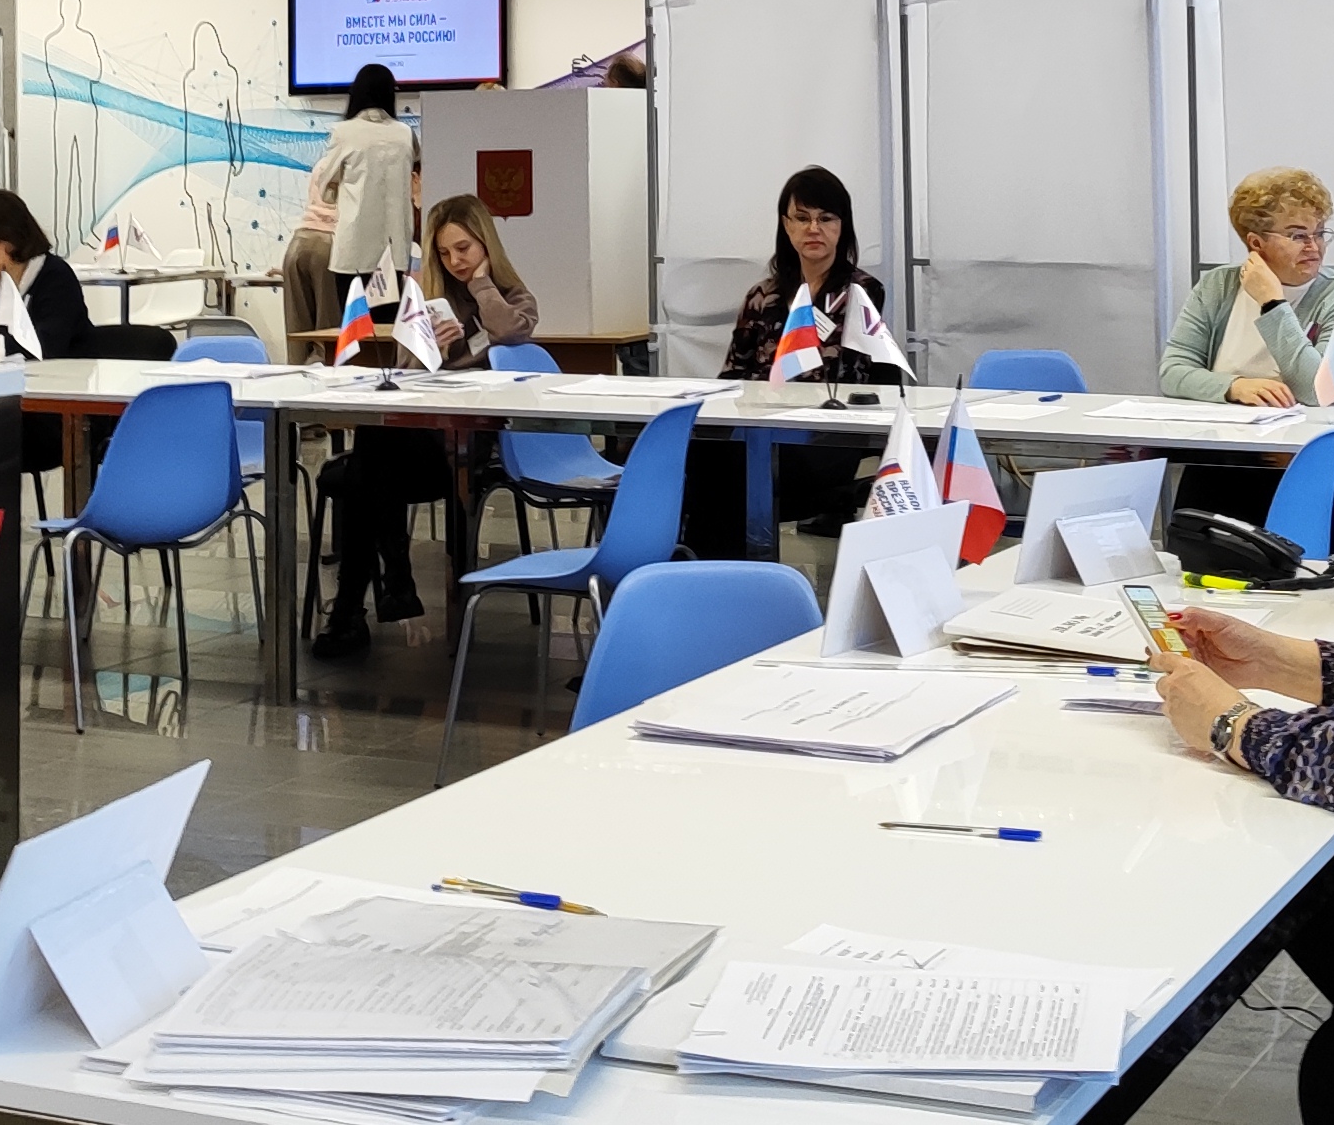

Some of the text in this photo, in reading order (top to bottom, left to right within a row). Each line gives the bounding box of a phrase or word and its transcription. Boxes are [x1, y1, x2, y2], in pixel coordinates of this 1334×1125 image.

[346, 15, 385, 29] ВМЕСТЕ
[388, 14, 407, 26] МЫ
[409, 13, 437, 26] СИЛА
[337, 29, 456, 47] ГОЛОСУЕМ ЗА РОССИЮ!
